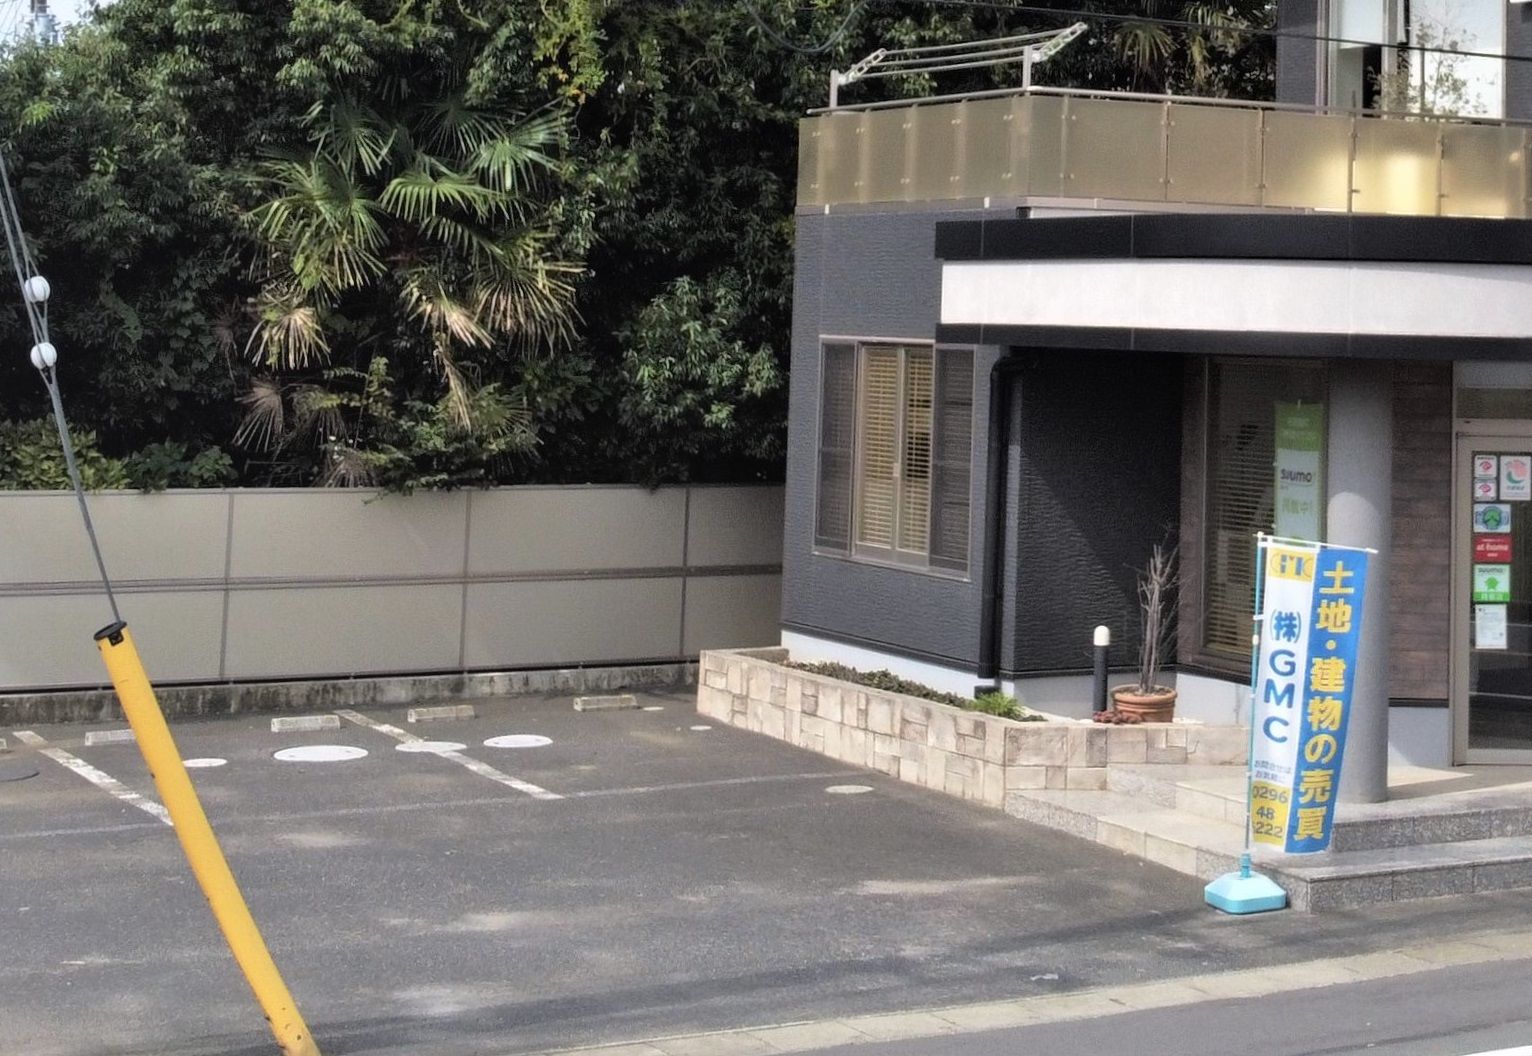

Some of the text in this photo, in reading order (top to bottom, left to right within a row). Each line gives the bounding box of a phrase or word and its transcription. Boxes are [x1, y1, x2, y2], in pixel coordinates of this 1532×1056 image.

[1293, 560, 1355, 841] 土地・建物の売買
[1252, 785, 1288, 804] 0296
[1256, 806, 1275, 820] 48
